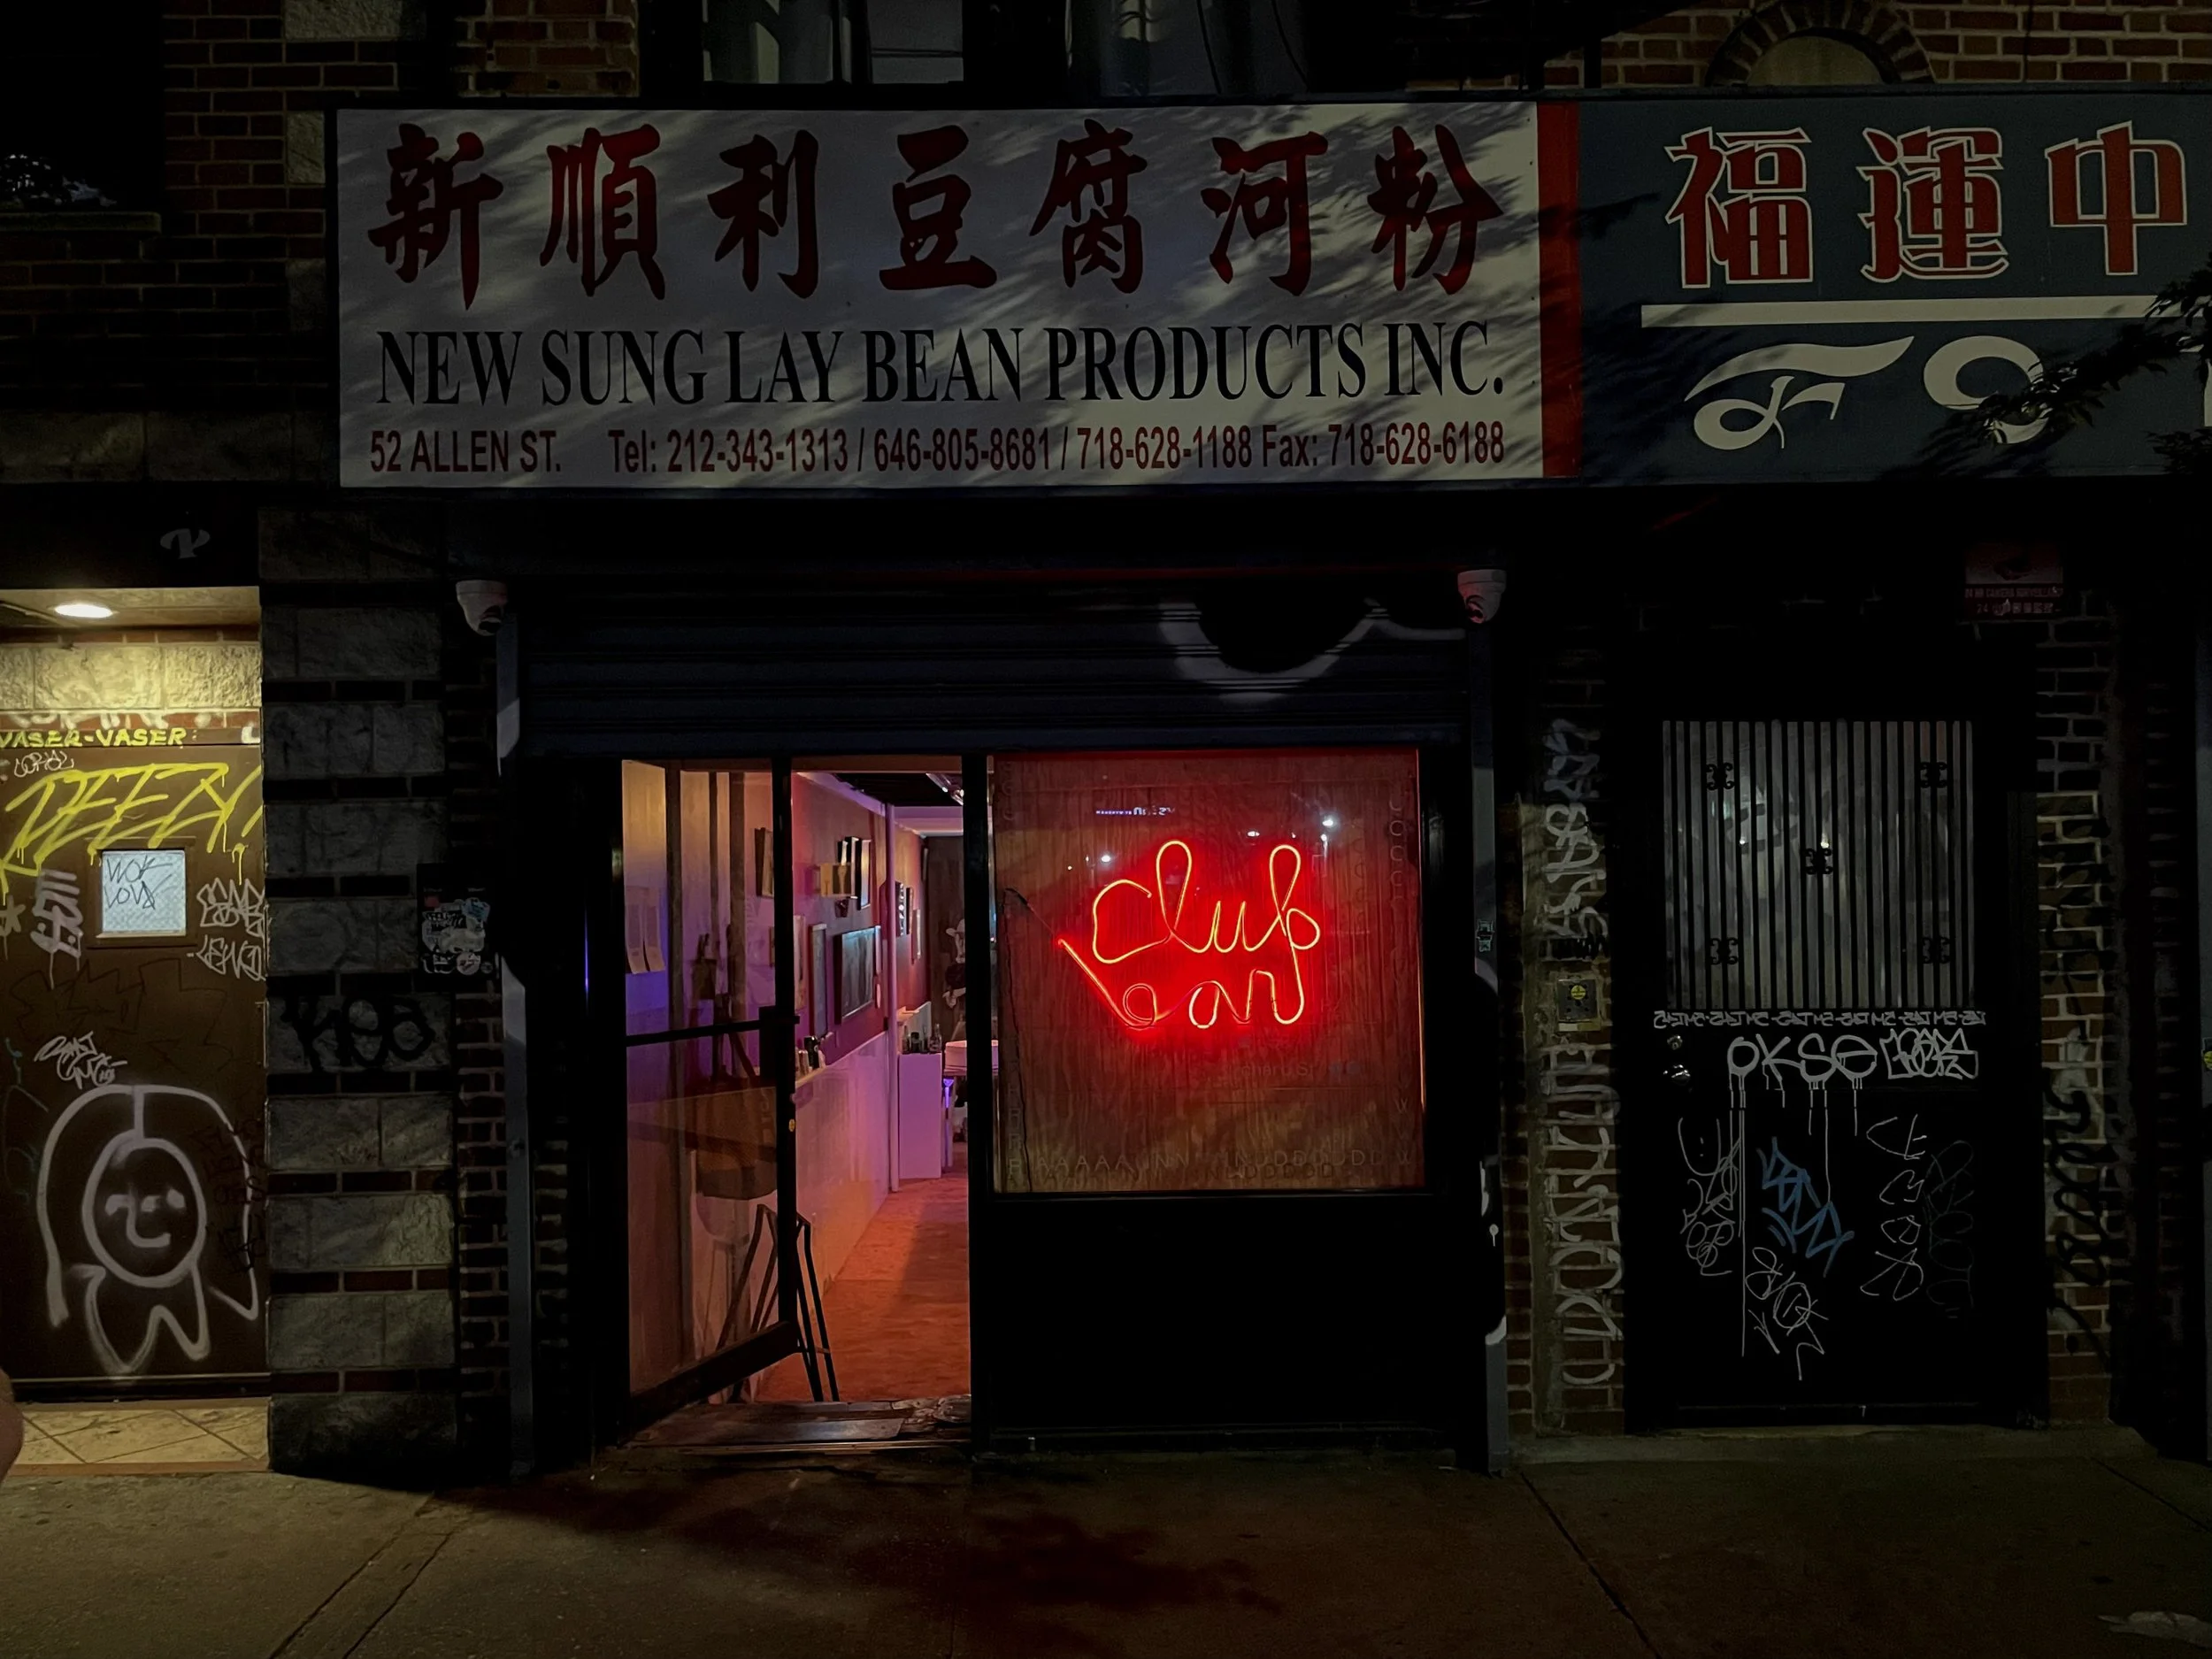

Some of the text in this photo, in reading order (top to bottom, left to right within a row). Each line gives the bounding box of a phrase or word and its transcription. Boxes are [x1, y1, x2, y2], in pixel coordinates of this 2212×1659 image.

[368, 119, 1503, 311] 新順利豆腐河粉
[376, 319, 1504, 406] NEW SUNG LAY BEAN PRODUCTS INC.
[369, 430, 402, 473] 52
[410, 429, 510, 473] ALLEN
[519, 429, 562, 473] ST.
[608, 428, 658, 473] Tel:
[666, 427, 849, 473] 212-343-1313
[873, 426, 1051, 472] 646-805-8681
[1078, 425, 1252, 471] 718-628-1188
[1262, 424, 1318, 469] Fax:
[1328, 421, 1504, 467] 718-628-6188
